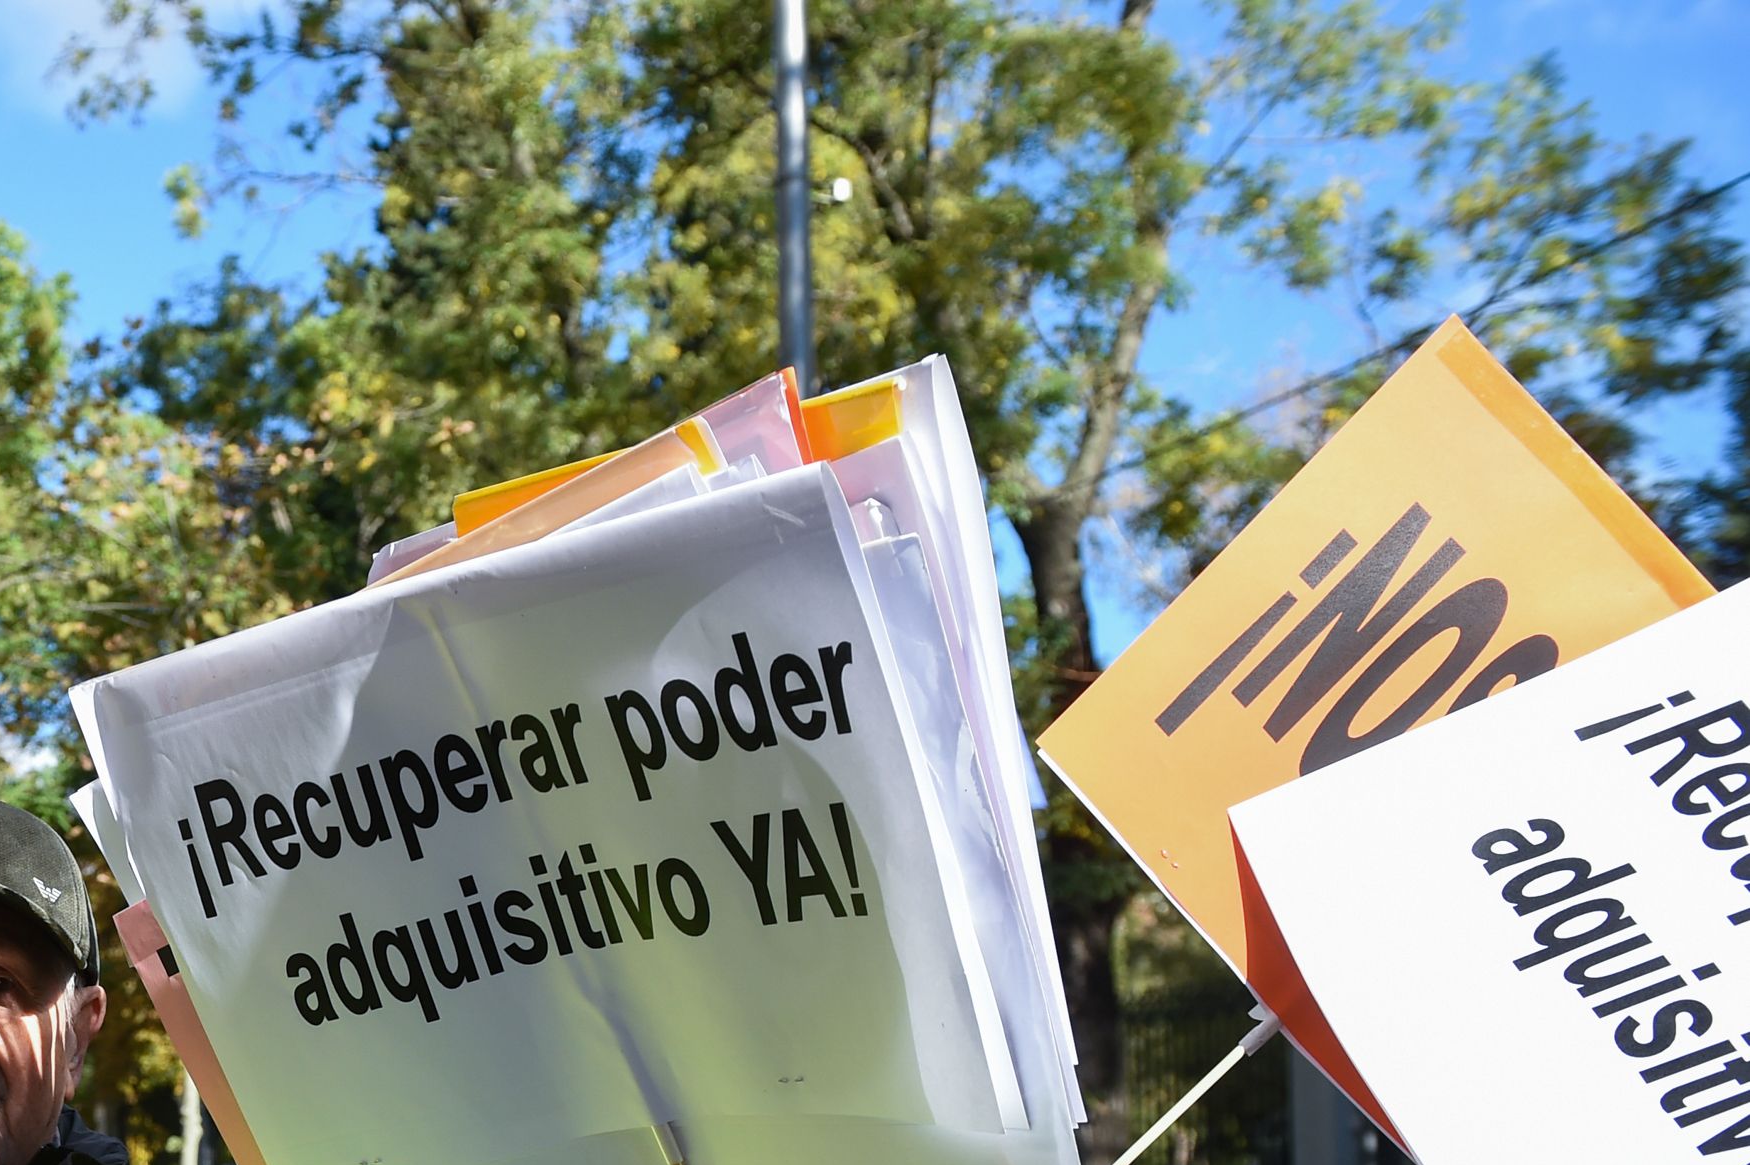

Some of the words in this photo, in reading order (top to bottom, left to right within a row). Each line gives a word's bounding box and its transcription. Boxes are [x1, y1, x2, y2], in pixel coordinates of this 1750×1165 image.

[178, 700, 590, 919] ¡Recuperar
[603, 631, 854, 802] poder
[285, 843, 711, 1023] adquisitivo
[711, 801, 868, 926] YA!
